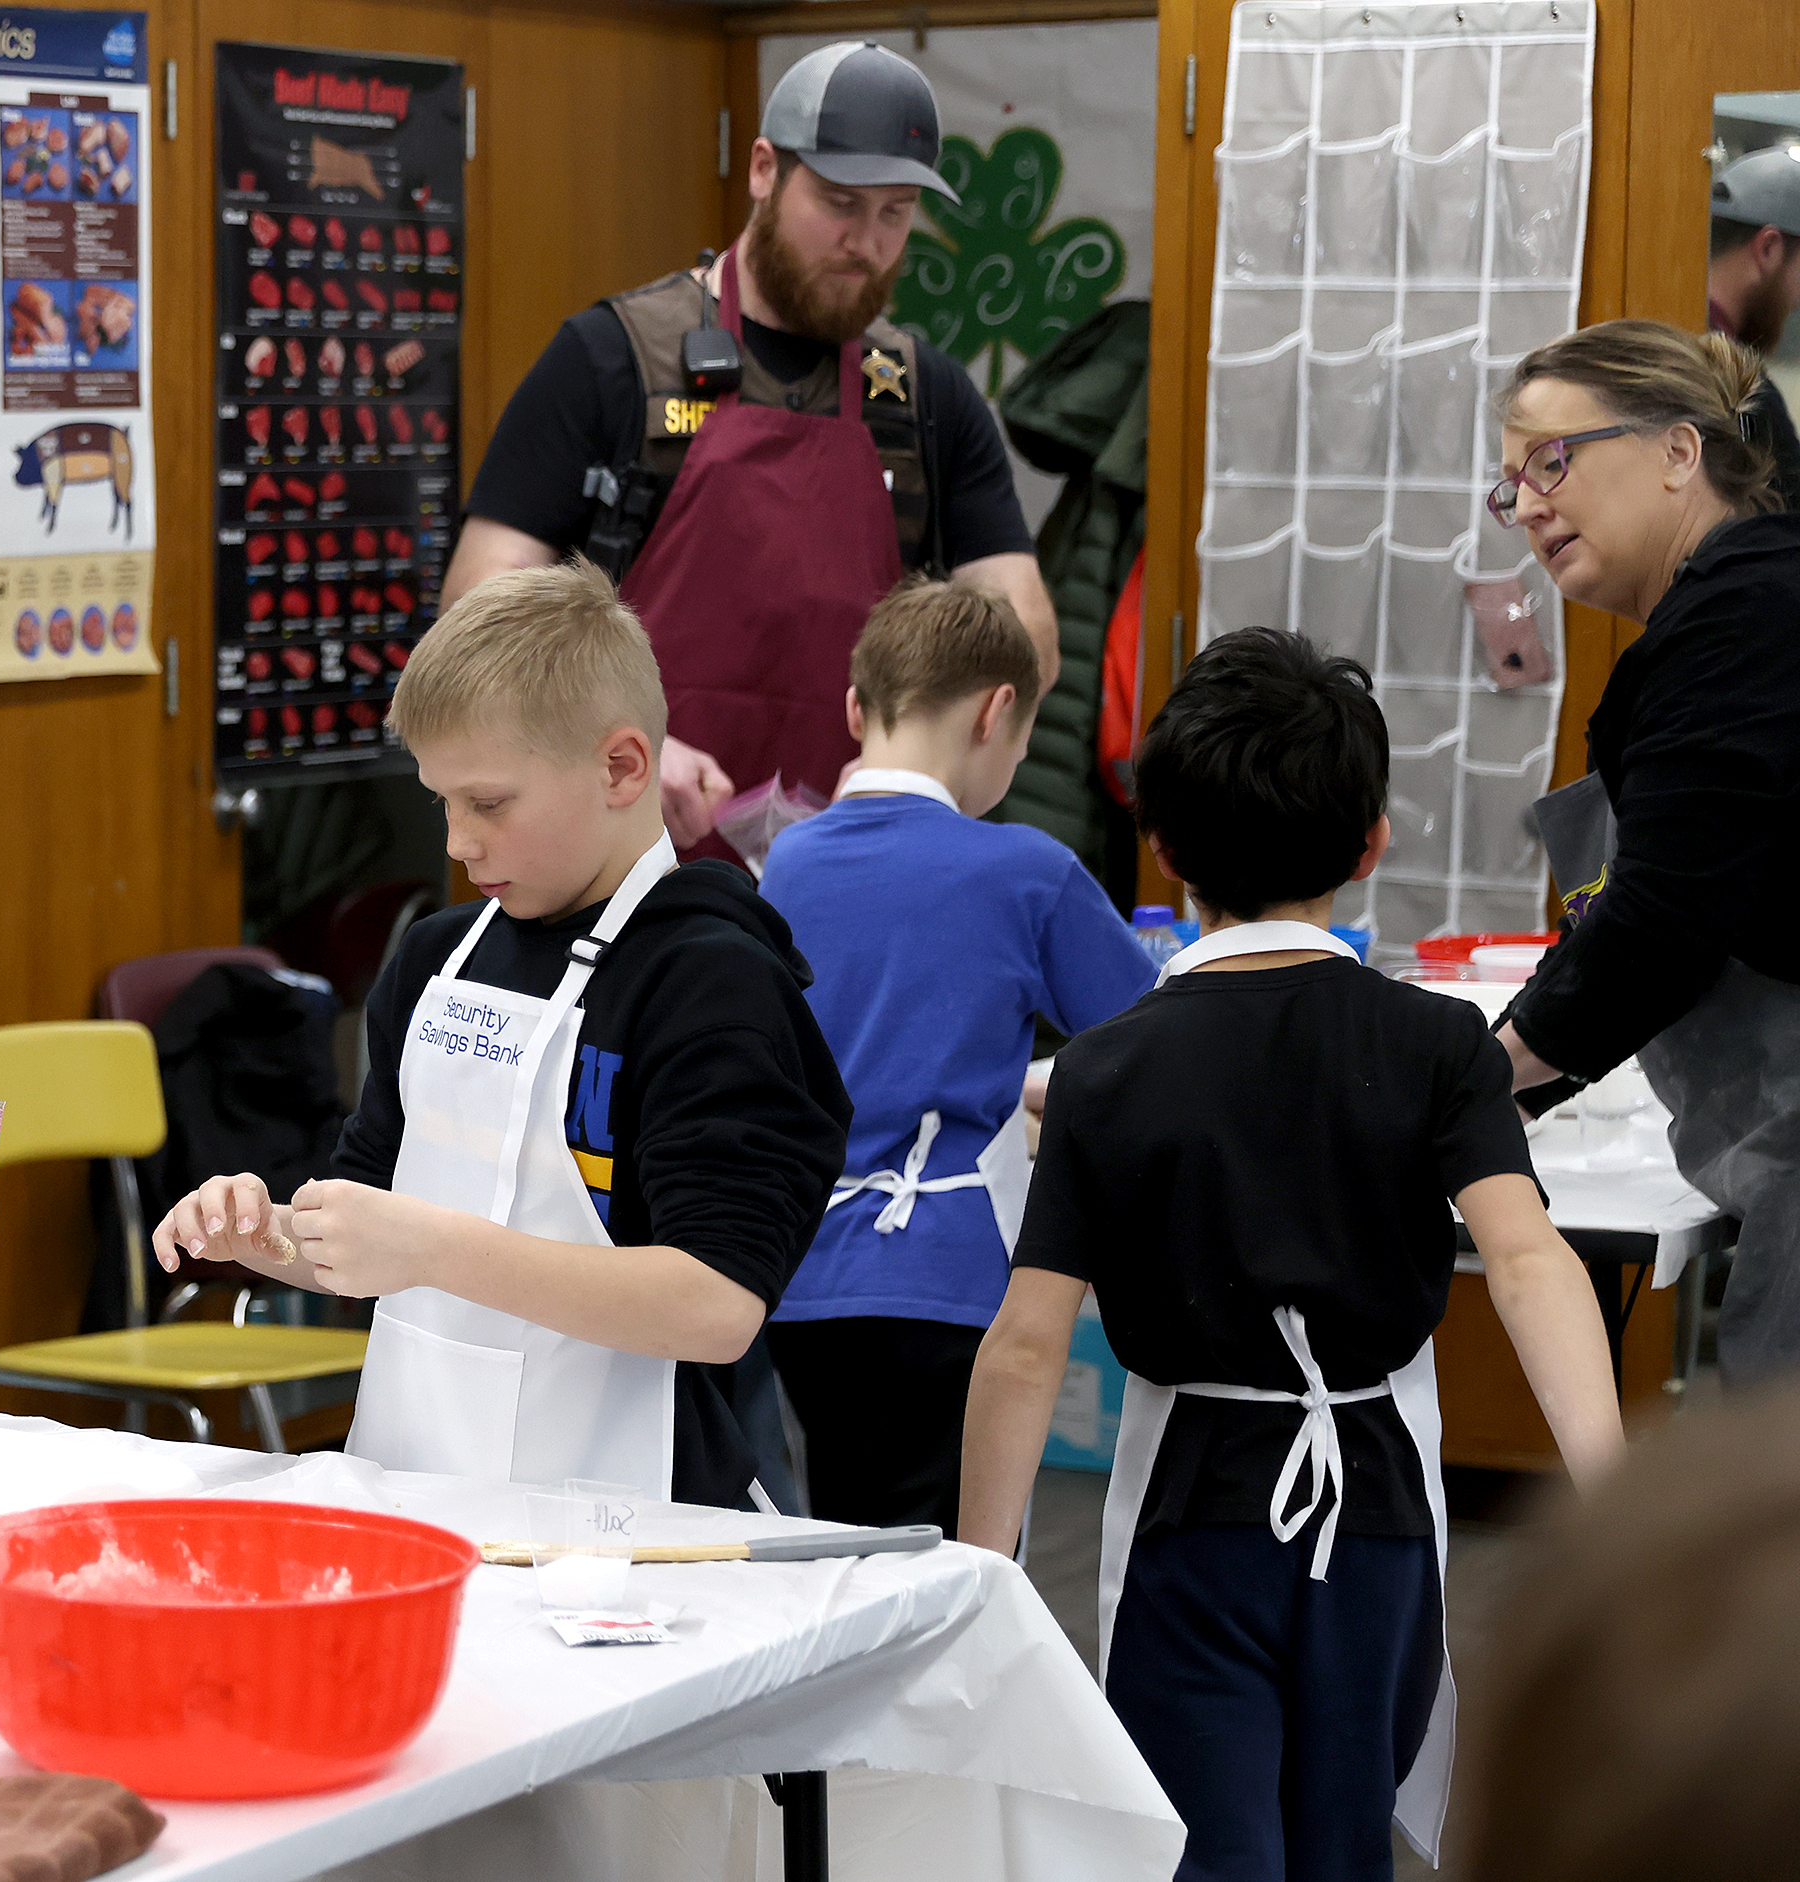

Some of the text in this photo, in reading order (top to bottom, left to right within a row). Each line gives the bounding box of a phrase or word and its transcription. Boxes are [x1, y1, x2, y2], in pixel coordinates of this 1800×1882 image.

[273, 66, 317, 106] Beef
[318, 71, 367, 111] Made
[664, 397, 717, 434] SHE
[443, 995, 511, 1036] Security
[418, 1019, 525, 1067] Savings Bank
